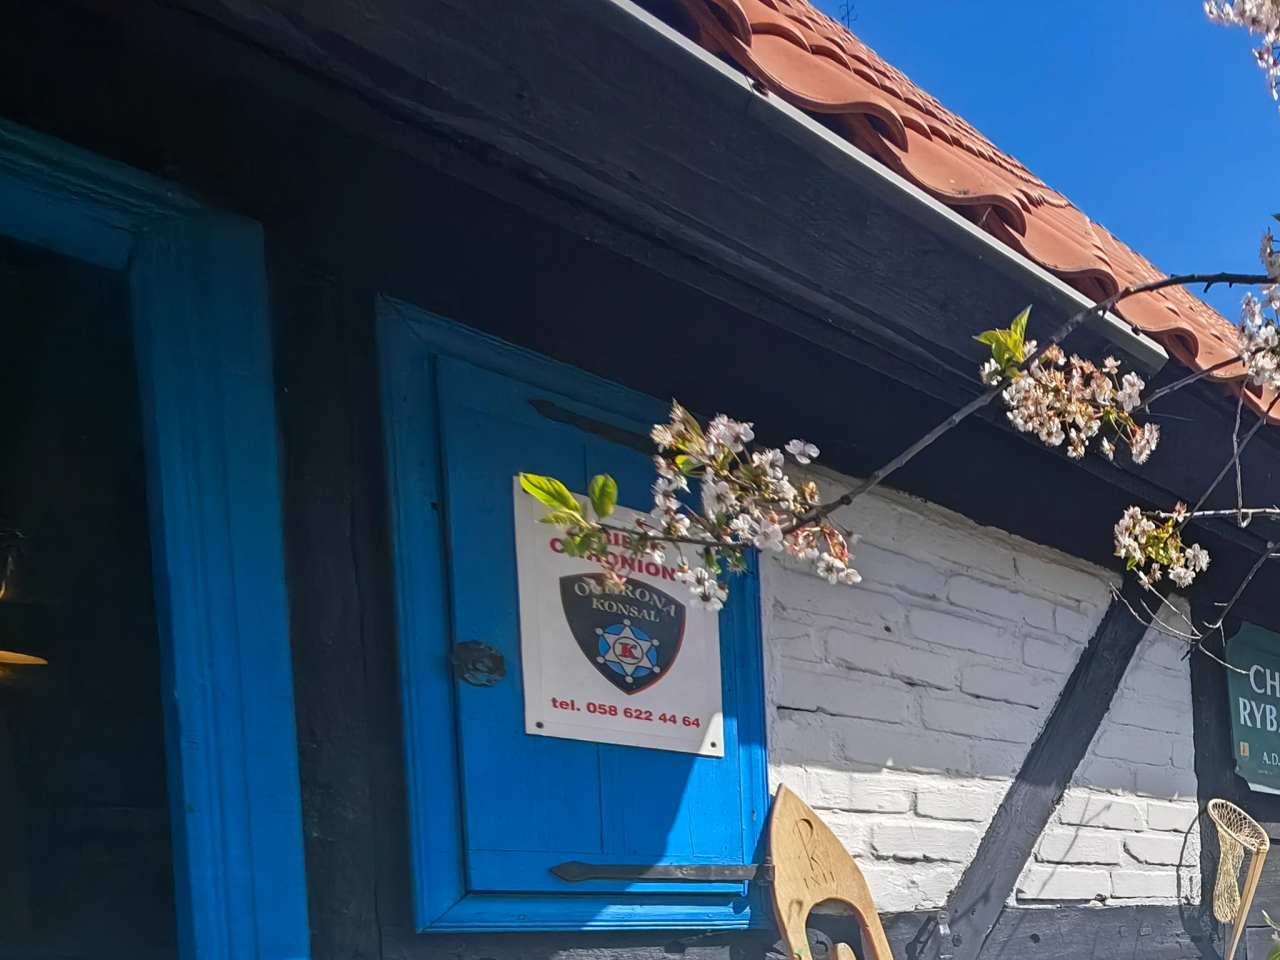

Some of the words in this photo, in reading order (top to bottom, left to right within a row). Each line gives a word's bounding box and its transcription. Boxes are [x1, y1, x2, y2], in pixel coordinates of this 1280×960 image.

[574, 581, 676, 617] ORONA
[592, 598, 660, 622] KONSAL
[551, 697, 581, 712] tel.
[586, 702, 618, 716] 058
[623, 708, 653, 721] 622
[658, 713, 677, 725] 44
[682, 716, 701, 728] 64
